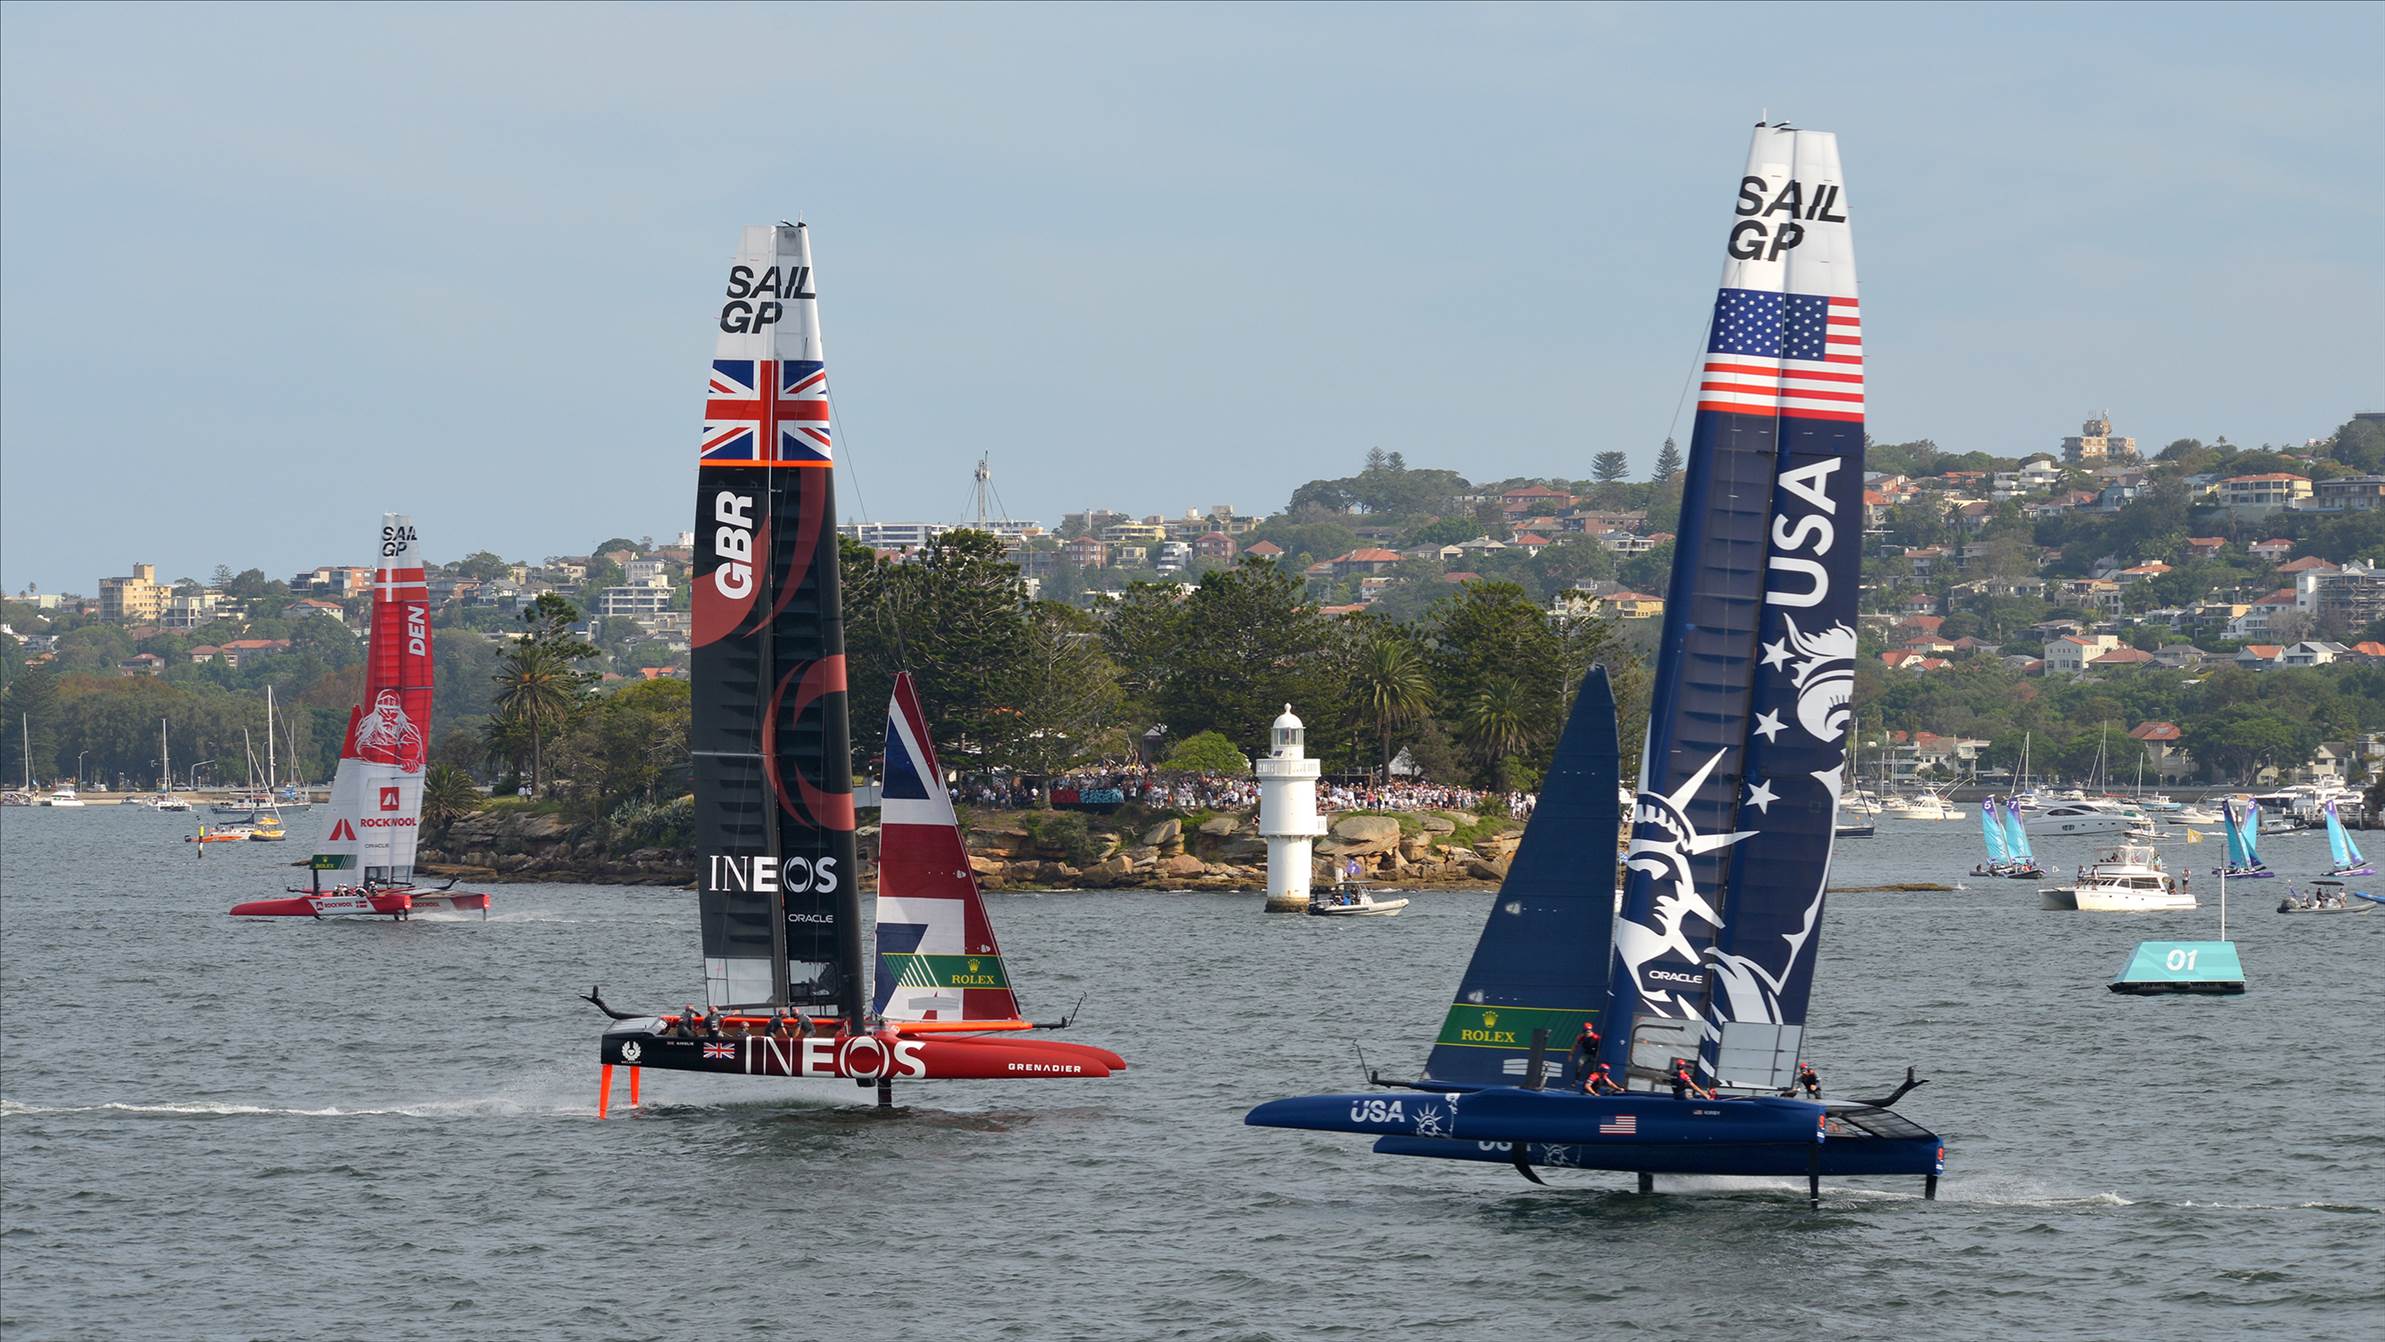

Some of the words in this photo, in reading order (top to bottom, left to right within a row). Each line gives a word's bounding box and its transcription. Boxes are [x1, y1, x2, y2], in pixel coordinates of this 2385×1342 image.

[1735, 175, 1847, 223] SAIL
[1728, 219, 1806, 262] GP
[725, 265, 817, 299] SAIL
[719, 300, 783, 334] GP
[382, 526, 418, 541] SAIL
[1766, 457, 1841, 607] USA
[382, 541, 407, 557] GP
[714, 490, 752, 600] GBR
[408, 605, 426, 656] DEN
[360, 817, 417, 828] ROCKWOOL
[708, 855, 838, 893] INEOS
[788, 913, 834, 923] ORACLE
[2166, 949, 2198, 971] 01
[951, 974, 995, 985] ROLEX
[1648, 970, 1703, 984] ORACLE
[1461, 1029, 1516, 1043] ROLEX
[745, 1035, 927, 1079] INEOS
[1008, 1063, 1082, 1073] GRENADIER
[1350, 1100, 1406, 1123] USA
